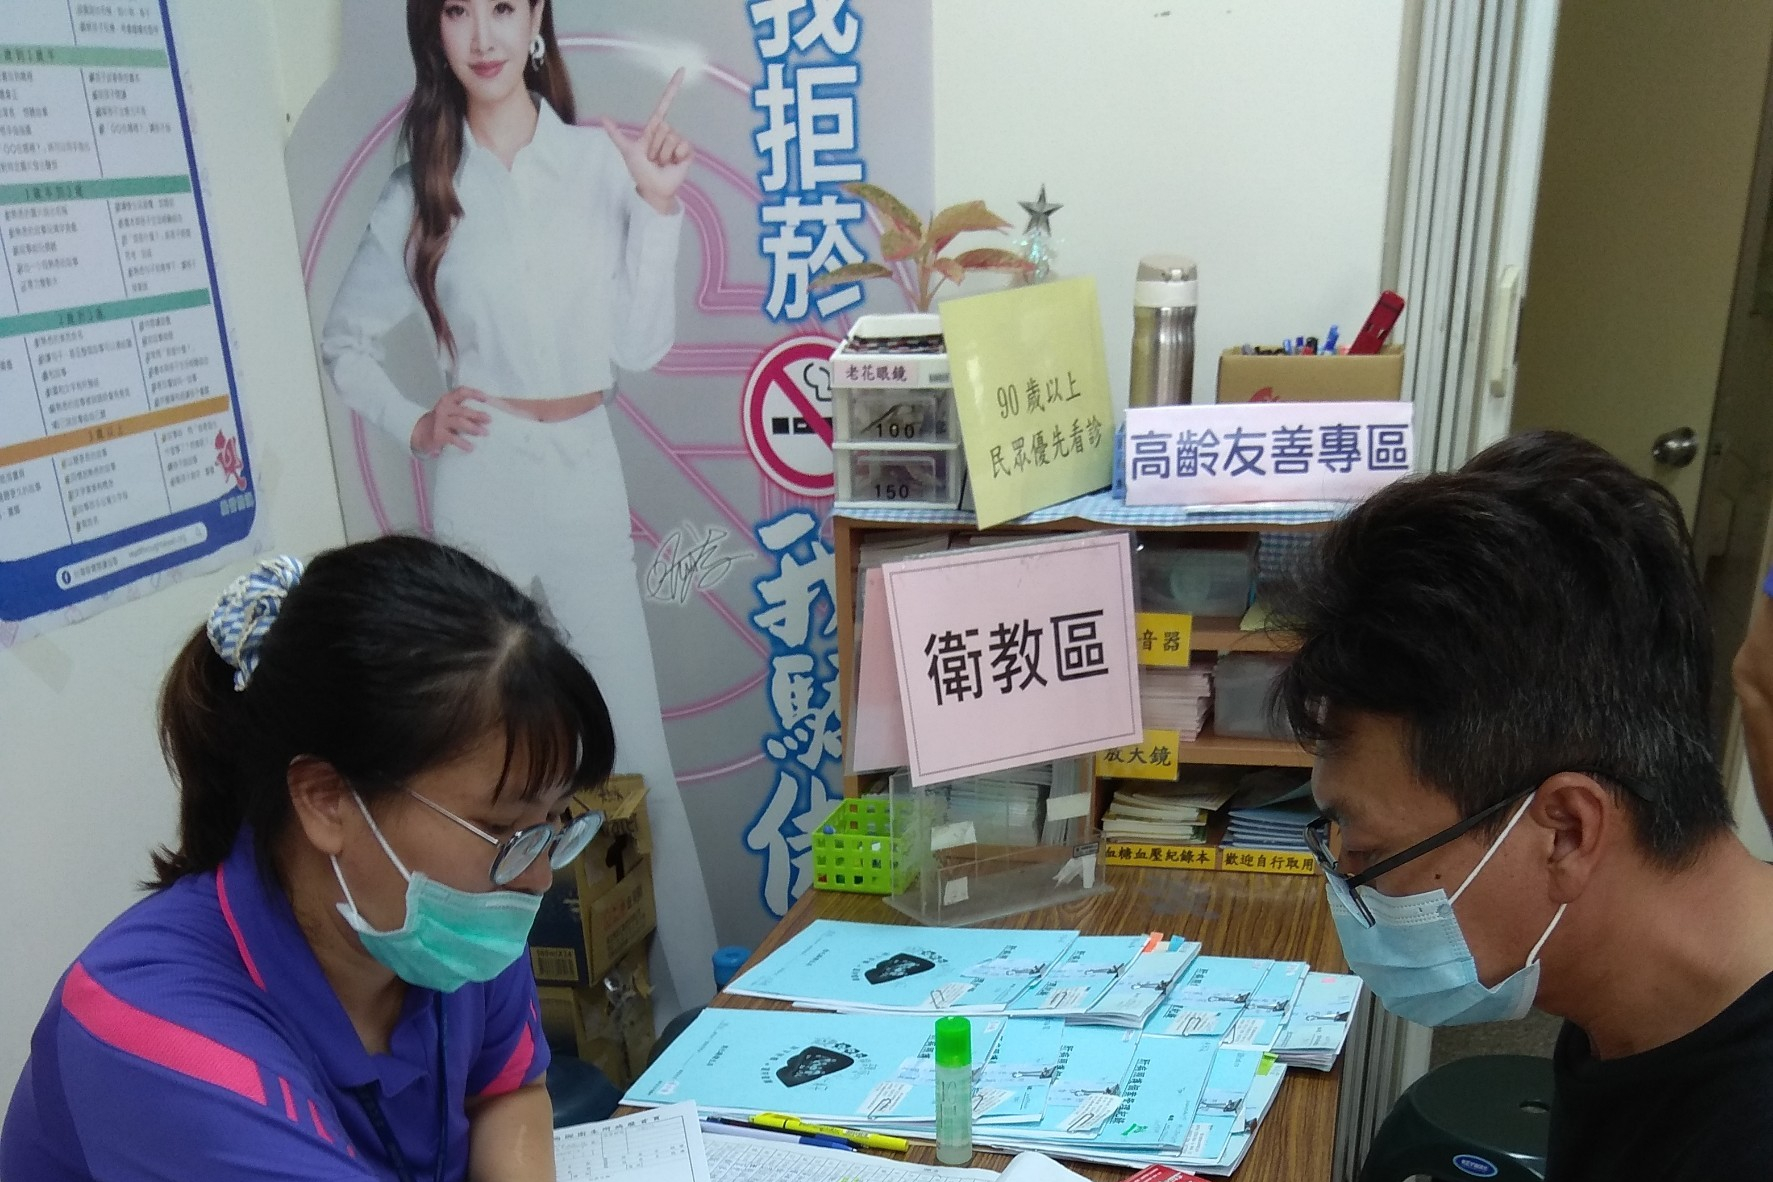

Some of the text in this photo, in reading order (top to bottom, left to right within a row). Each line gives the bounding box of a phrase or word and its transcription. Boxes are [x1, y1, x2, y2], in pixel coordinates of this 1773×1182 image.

[845, 364, 908, 382] 老花眼鏡
[876, 423, 915, 439] 100
[990, 415, 1103, 480] 民眾優先看診
[1130, 423, 1410, 481] 高齡友善專區
[875, 484, 910, 500] 150
[924, 609, 1110, 706] 衛教區
[1104, 746, 1171, 767] 放大鏡
[1105, 846, 1211, 865] 血糖血壓紀錄本
[1224, 852, 1314, 873] 歡迎自行取用
